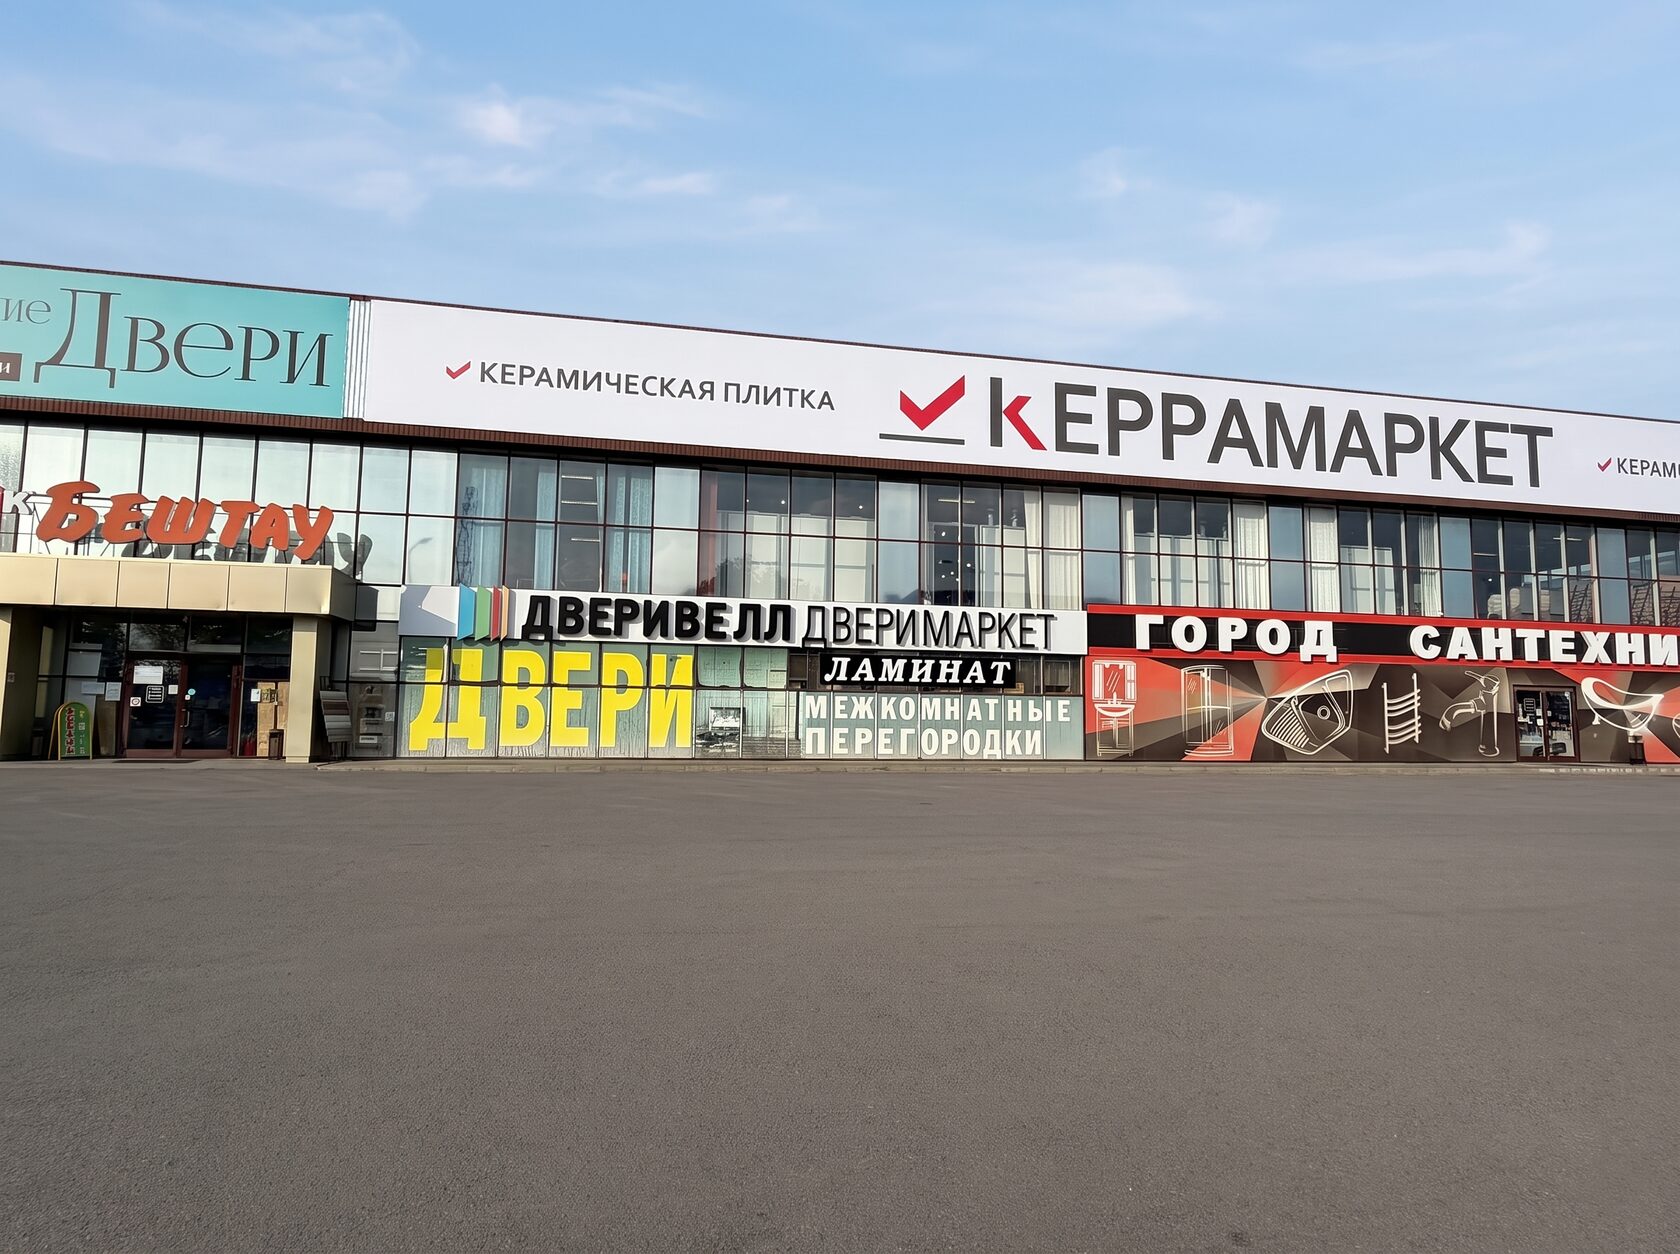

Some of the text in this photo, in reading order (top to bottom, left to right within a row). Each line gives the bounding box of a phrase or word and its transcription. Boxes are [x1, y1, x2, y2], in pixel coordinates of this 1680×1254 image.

[479, 361, 836, 411] КЕРАМИЧЕСКАЯ ПЛИТКА
[1617, 457, 1680, 478] КЕРАМ
[521, 594, 1056, 651] ДВЕРИВЕЛЛ ДВЕРИМАРКЕТ
[1135, 614, 1680, 667] ГОРОД САНТЕХНИ
[823, 657, 1012, 685] ЛАМИНАТ
[408, 647, 694, 751] ДВЕРИ
[804, 694, 1072, 723] МЕЖКОМНАТНЫЕ
[805, 727, 1043, 760] ПЕРЕГОРОДКИ
